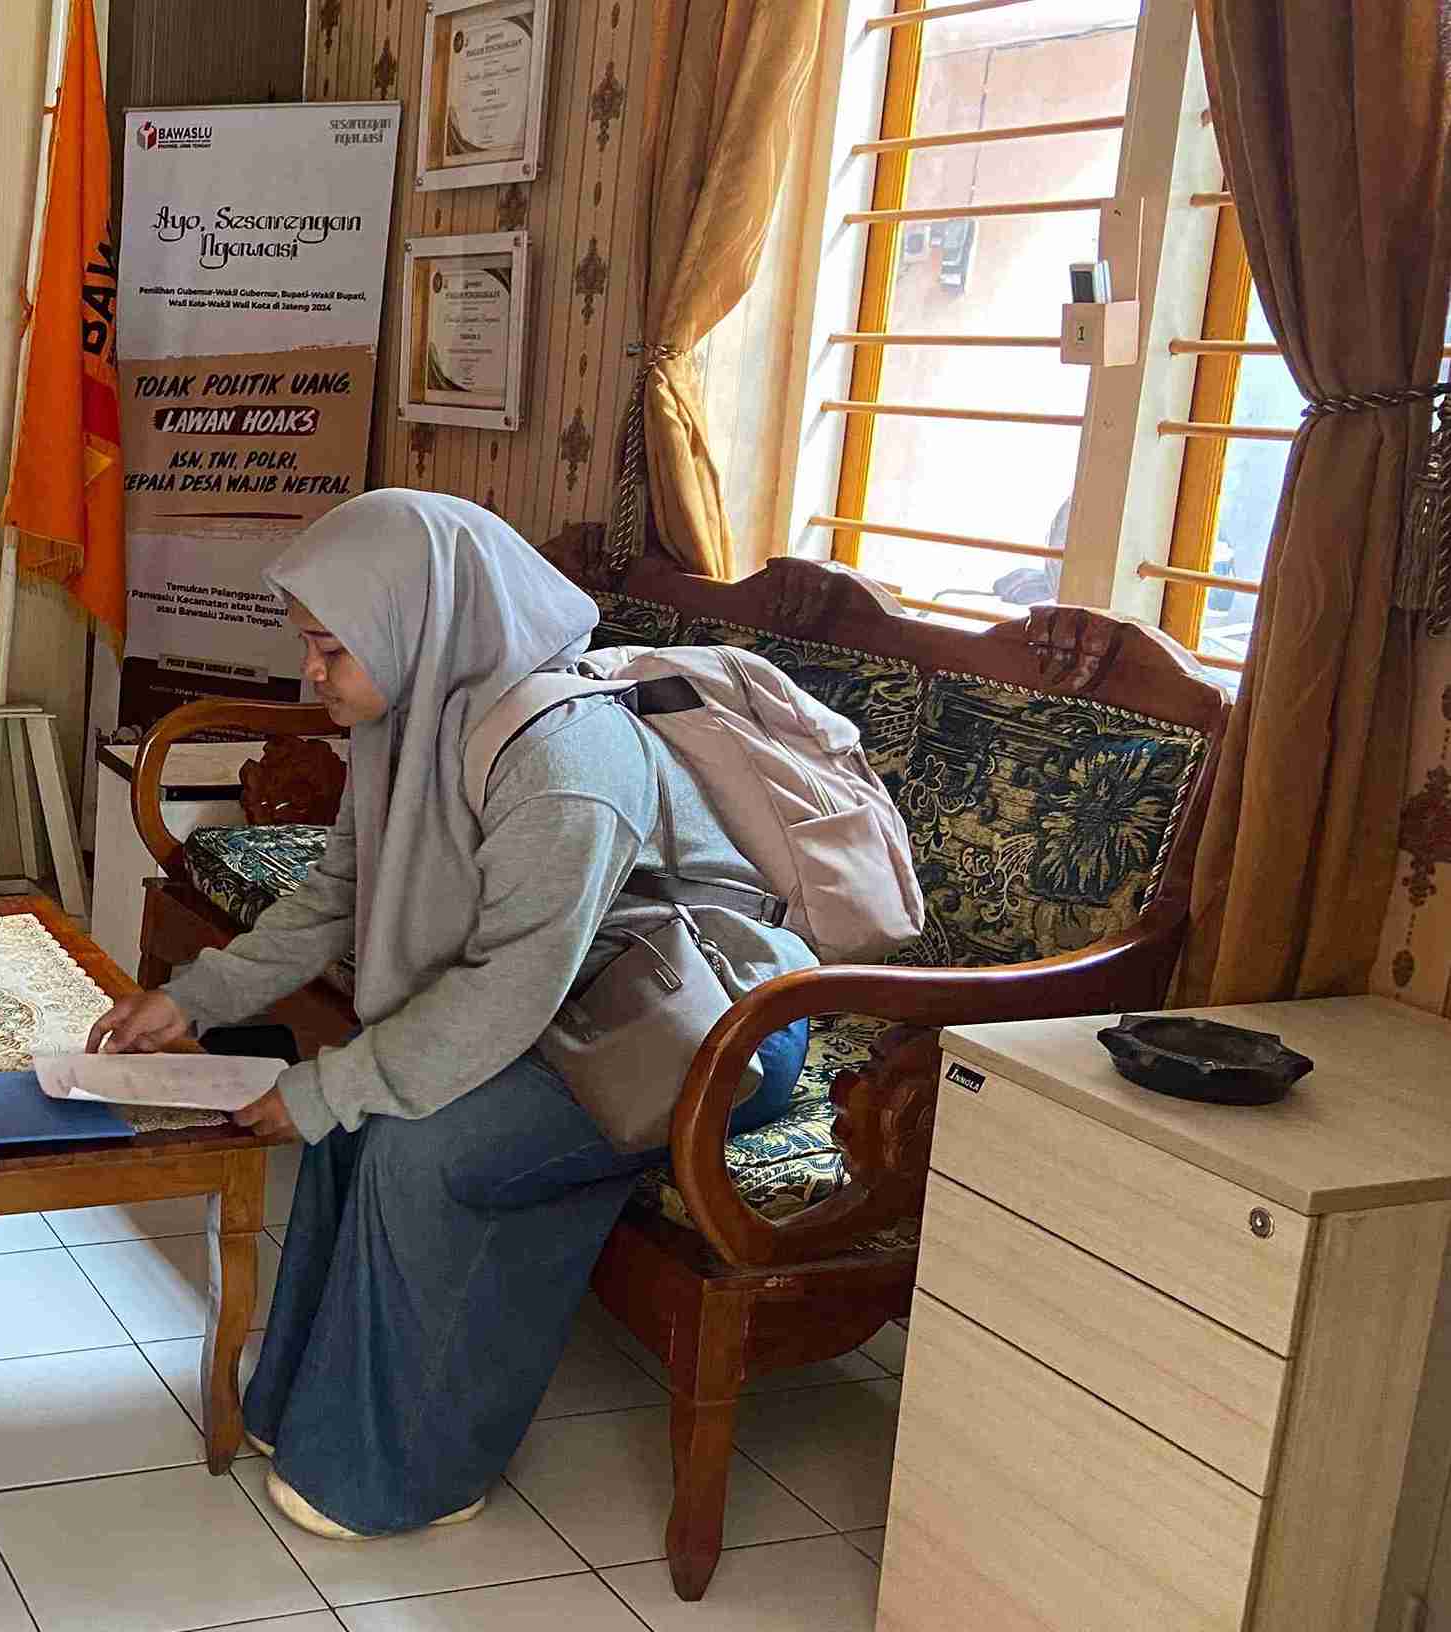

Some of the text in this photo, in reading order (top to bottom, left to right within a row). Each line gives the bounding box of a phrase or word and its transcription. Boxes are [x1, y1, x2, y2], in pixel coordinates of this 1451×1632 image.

[159, 127, 212, 139] BAWASLU
[151, 206, 362, 244] Ayo, Sesarengan
[199, 233, 299, 269] Ngawasi
[251, 301, 271, 310] Kota
[272, 302, 280, 310] di
[281, 302, 310, 312] Jateng
[311, 303, 332, 312] 2024
[1077, 326, 1085, 341] 1
[135, 373, 351, 398] TOLAK POLITIK UANG.
[161, 408, 317, 433] LAWAN HOAKS.
[178, 474, 222, 492] DESA
[226, 475, 279, 493] WAJIB
[131, 589, 174, 602] Panwaslu
[177, 595, 229, 608] Kecamatan
[230, 602, 253, 611] atau
[166, 582, 275, 602] Temukan Pelanggaran?
[156, 605, 176, 614] atau
[178, 607, 217, 619] Bawaslu
[218, 611, 244, 623] Jawa
